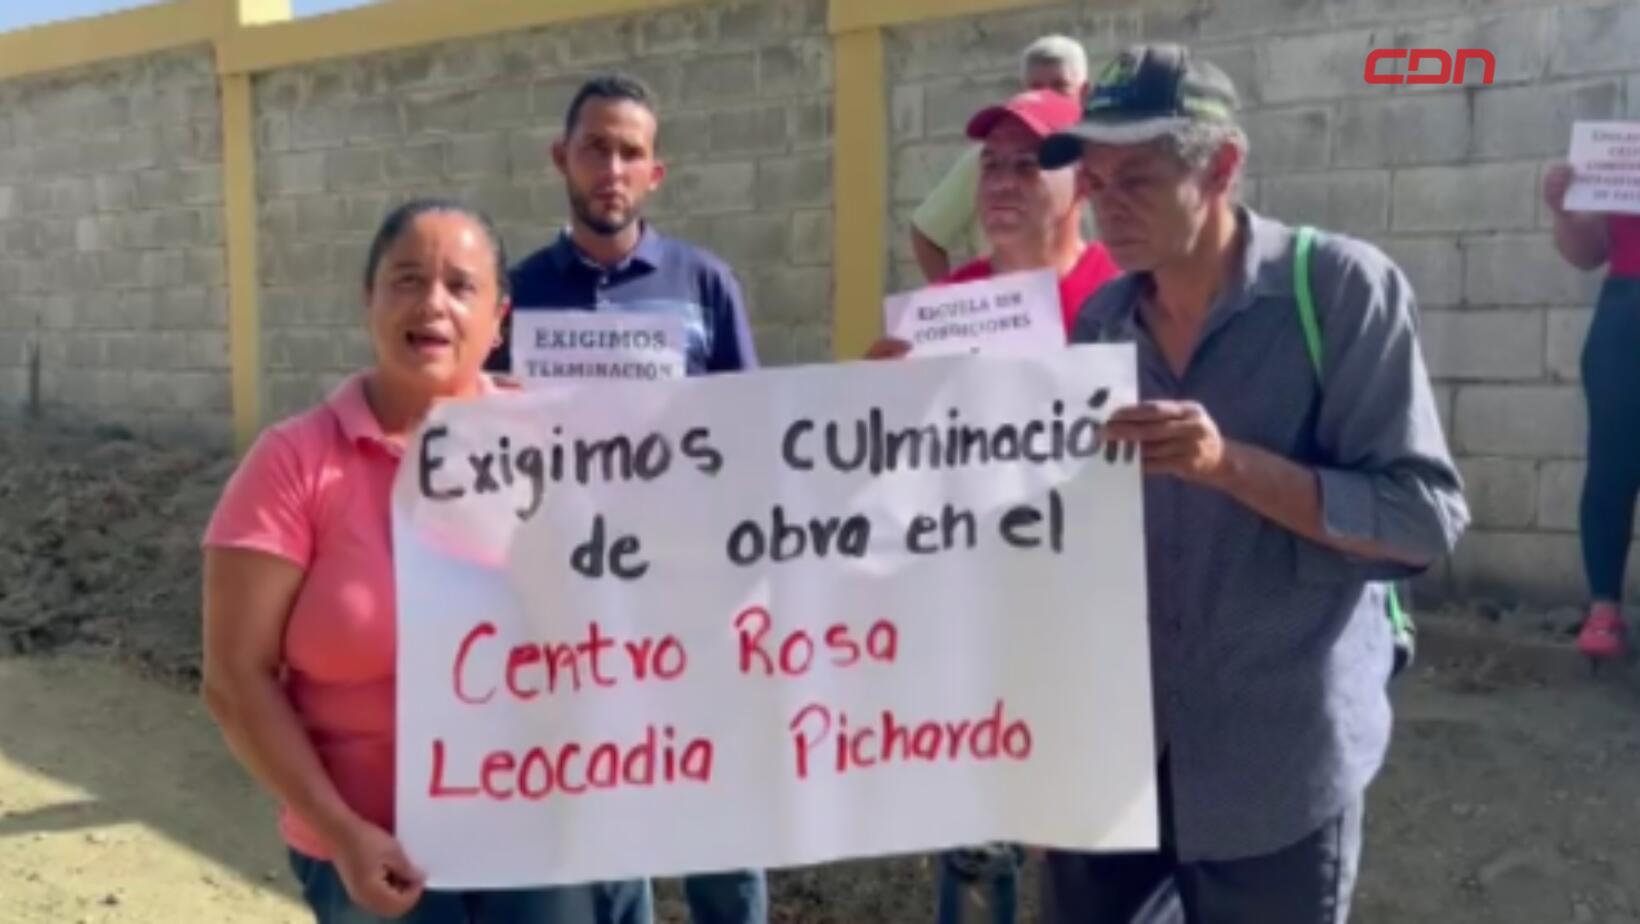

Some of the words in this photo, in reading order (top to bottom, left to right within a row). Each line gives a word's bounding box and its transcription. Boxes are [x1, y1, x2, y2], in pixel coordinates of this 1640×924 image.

[534, 328, 667, 349] EXIGIMOS
[418, 426, 724, 521] Exigimos
[570, 513, 649, 579] de
[727, 505, 871, 566] obra
[906, 503, 978, 554] en
[1000, 489, 1064, 553] el
[453, 621, 687, 704] Centro
[734, 606, 898, 677] Rosa
[429, 724, 714, 800] Leocadia
[789, 698, 1032, 779] Pichardo
